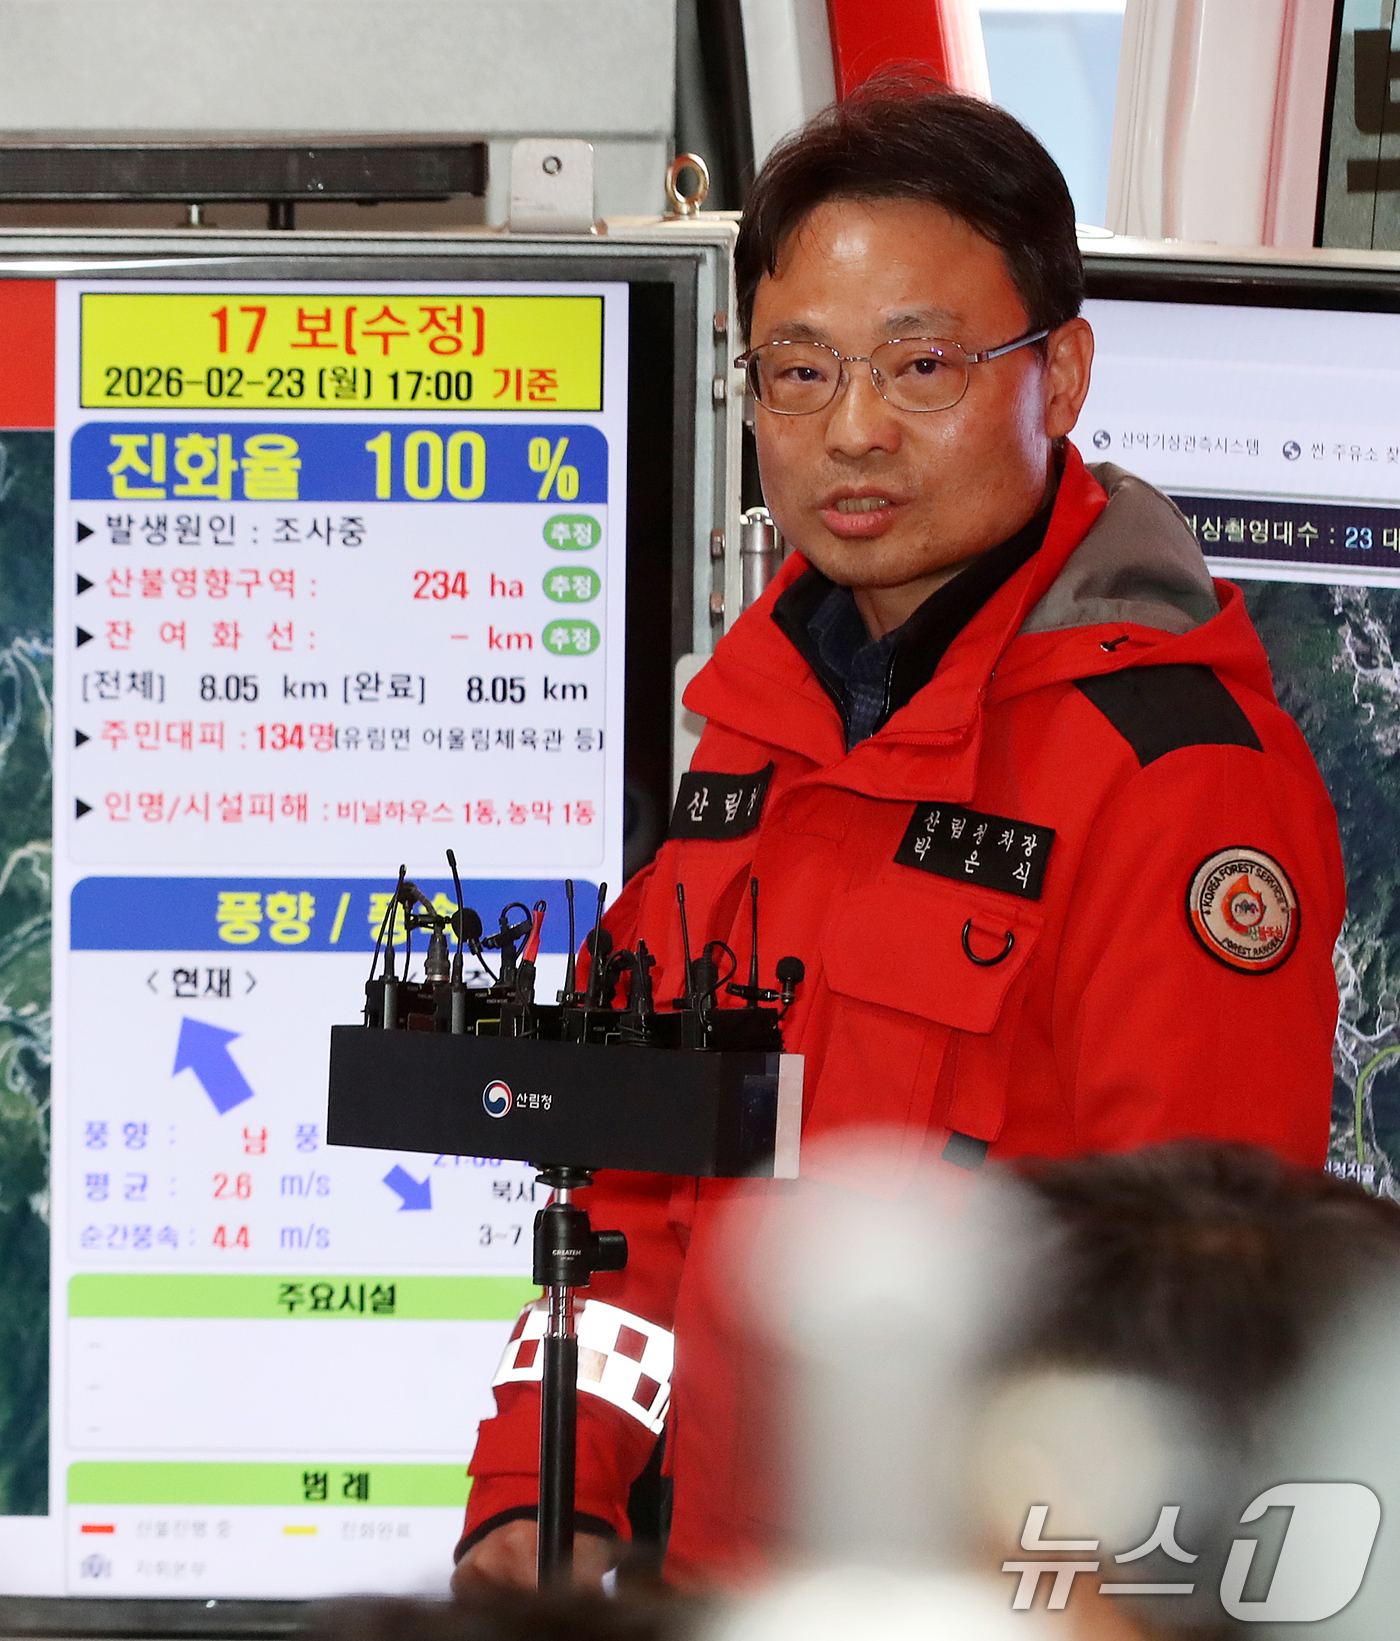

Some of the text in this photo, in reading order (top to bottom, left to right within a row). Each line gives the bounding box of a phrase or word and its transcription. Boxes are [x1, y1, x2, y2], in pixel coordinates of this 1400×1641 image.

[211, 305, 267, 354] 17
[104, 366, 305, 399] 2026-02-23
[388, 370, 473, 401] 17:00
[493, 368, 558, 402] 기준
[107, 430, 579, 501] 진화율 100 %
[1333, 444, 1377, 462] 주유소
[106, 514, 235, 546] 발생원인
[274, 516, 366, 547] 조사중
[550, 522, 593, 546] 추정
[1345, 527, 1373, 549] 23
[106, 567, 295, 599] 산불영향구역
[414, 570, 469, 600] 234
[491, 573, 523, 598] ha
[550, 574, 593, 598] 추정
[489, 625, 533, 650] km
[550, 627, 593, 651] 추정
[200, 674, 259, 702] 8.05
[284, 674, 327, 699] km
[467, 676, 526, 704] 8.05
[544, 676, 587, 700] km
[101, 720, 225, 752] 주민대피
[423, 728, 562, 752] 어울림체육관
[105, 791, 308, 823] 인명/시설피해
[337, 799, 453, 825] 비닐하우스
[1203, 876, 1222, 908] KOREA
[1218, 863, 1256, 881] FOREST
[215, 891, 316, 945] 풍향
[1221, 937, 1251, 957] FOREST
[173, 967, 230, 998] 현재
[517, 1093, 551, 1110] 산림청
[243, 1127, 268, 1155] 남
[295, 1123, 319, 1153] 풍
[213, 1172, 252, 1200] 2.6
[280, 1170, 330, 1198] m/s
[493, 1180, 535, 1203] 북서
[81, 1224, 178, 1251] 순간풍속
[212, 1224, 250, 1249] 4.4
[280, 1223, 330, 1249] m/s
[278, 1283, 396, 1316] 주요시설
